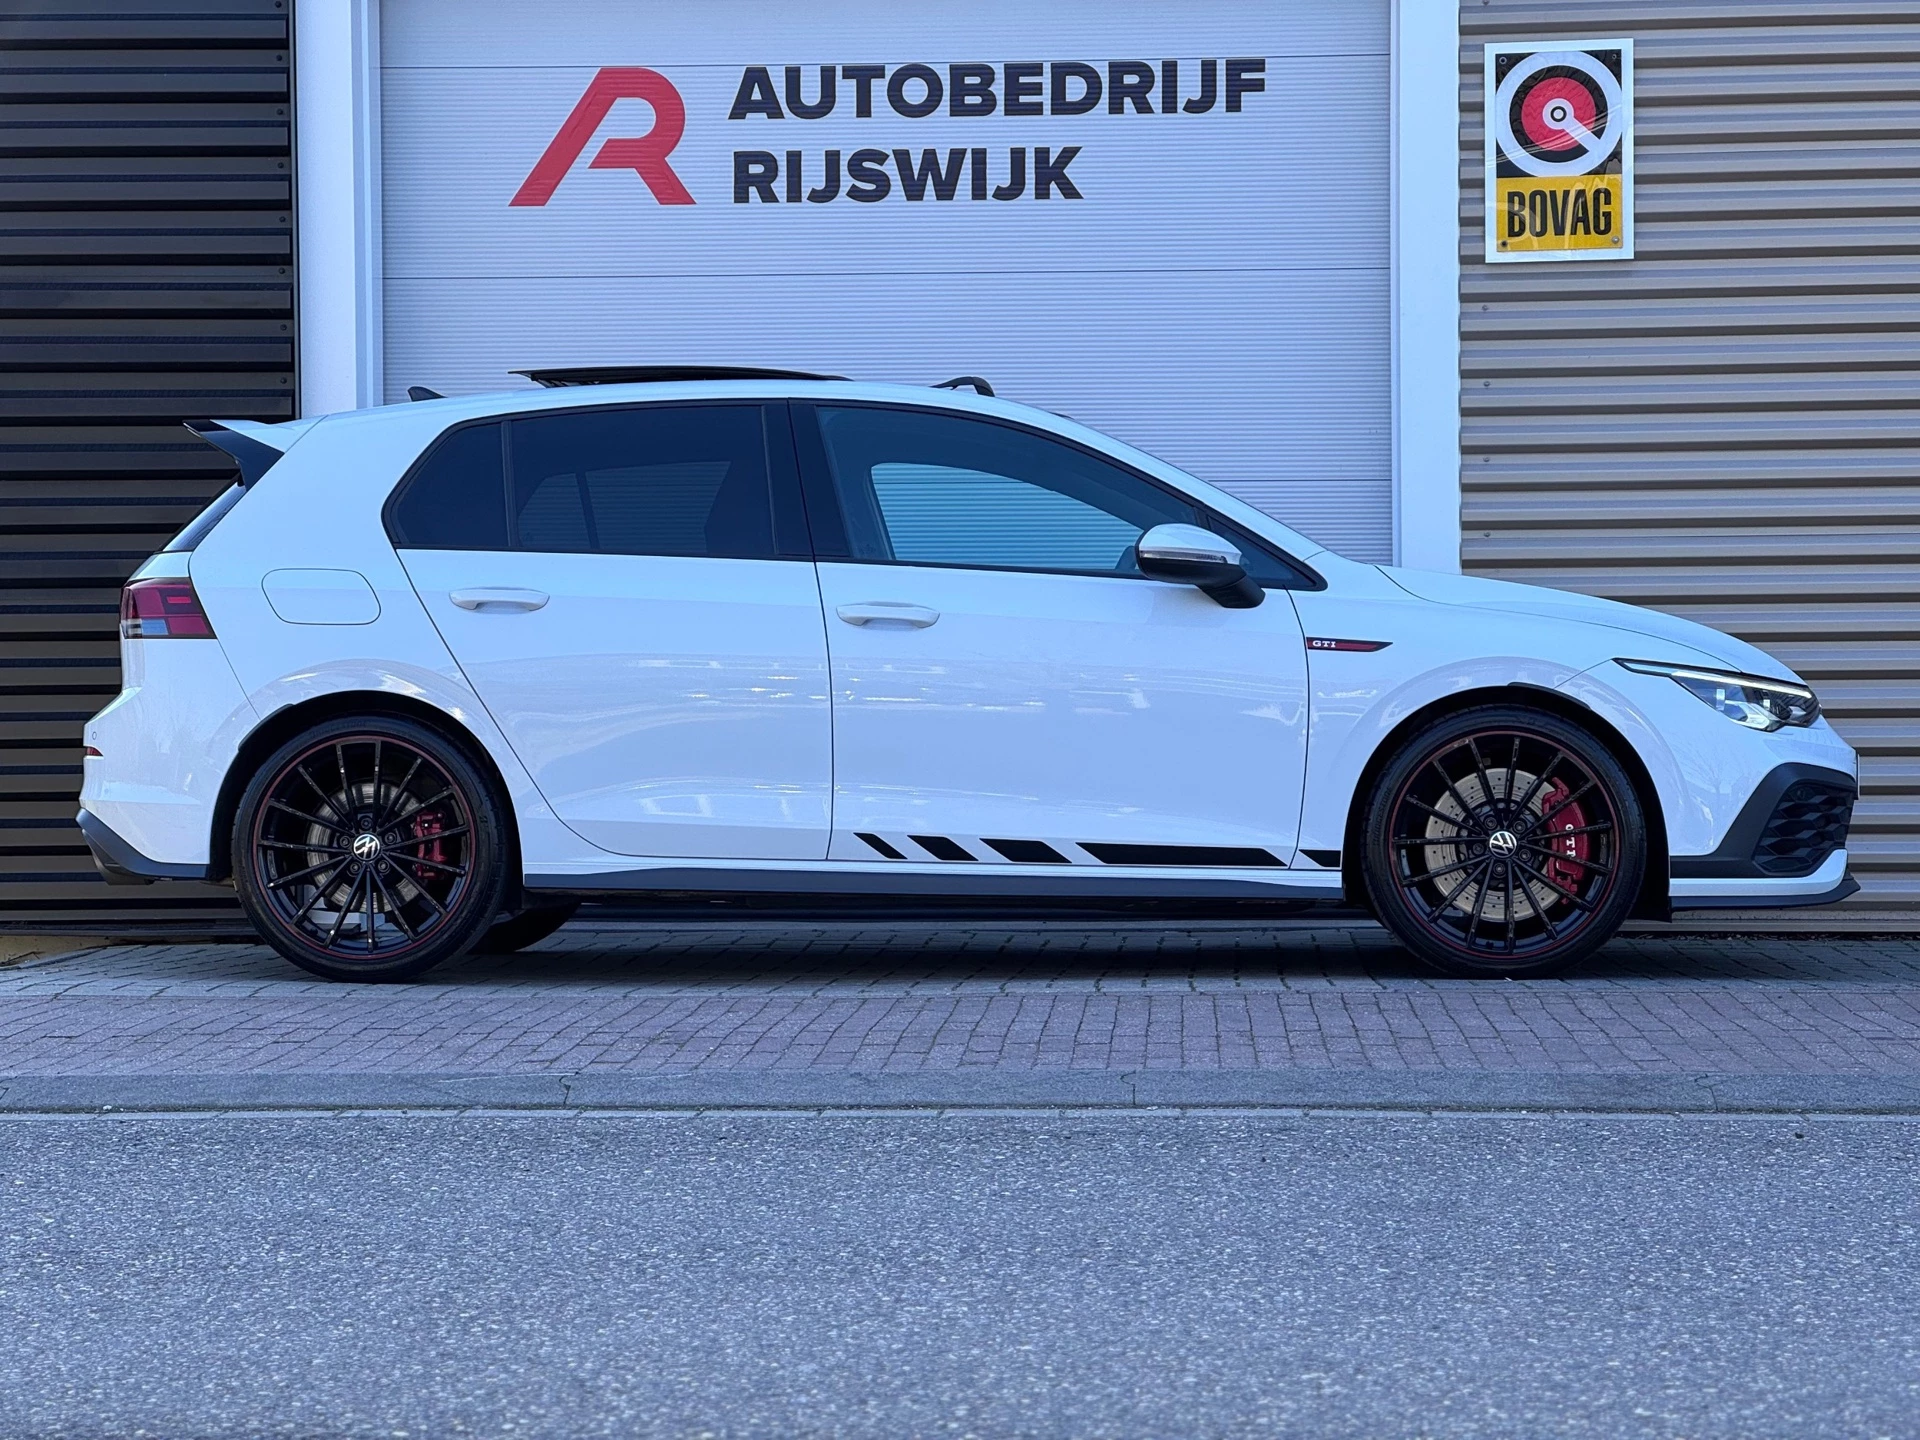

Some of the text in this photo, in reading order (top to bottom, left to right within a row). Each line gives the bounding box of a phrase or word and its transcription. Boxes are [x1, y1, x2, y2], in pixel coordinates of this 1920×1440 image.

[728, 58, 1267, 120] AUTOBEDRIJF
[732, 146, 1085, 205] RIJSWIJK
[1506, 187, 1613, 239] BOVAG
[1312, 639, 1337, 649] GTI
